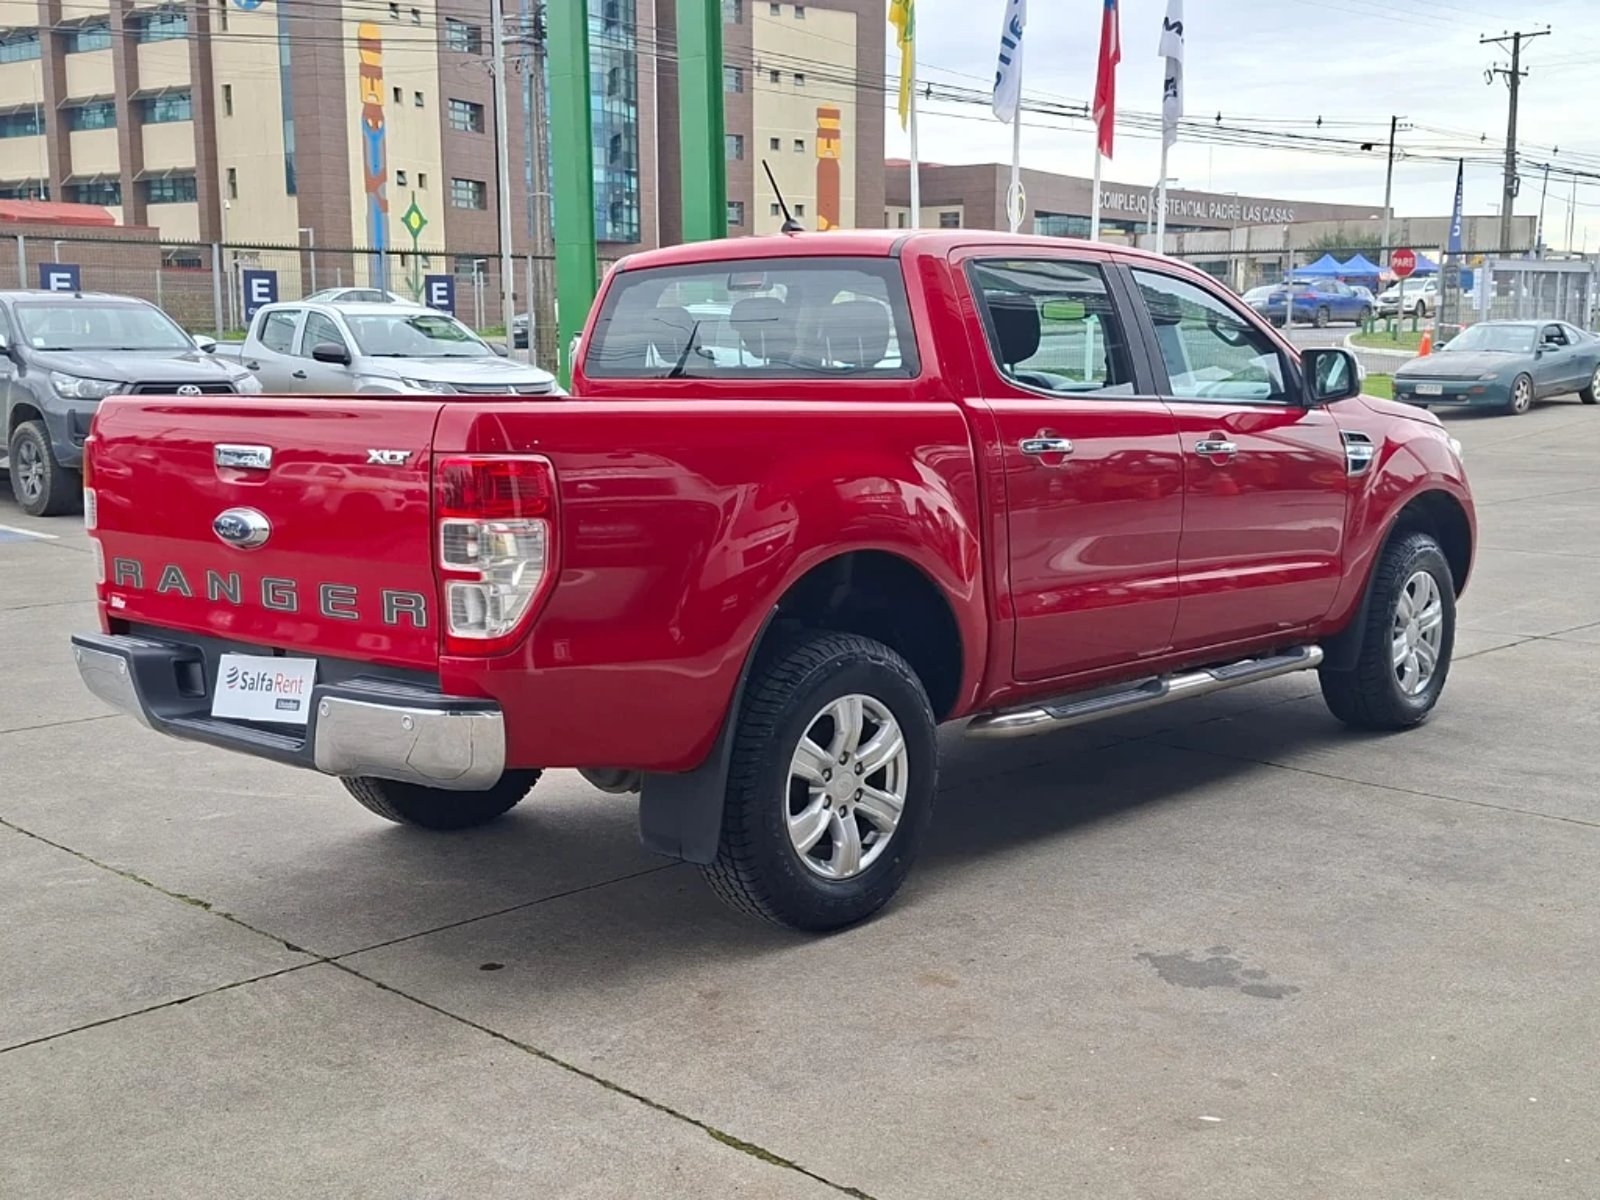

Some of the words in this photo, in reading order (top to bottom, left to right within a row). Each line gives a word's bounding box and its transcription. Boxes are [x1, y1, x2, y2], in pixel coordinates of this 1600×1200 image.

[1098, 191, 1148, 215] COMPLEJO
[1148, 195, 1209, 218] ASSTENCIAL
[1242, 204, 1261, 222] LAS
[1262, 207, 1295, 224] CASAS
[1392, 257, 1415, 268] PARE
[251, 278, 271, 302] E
[432, 282, 449, 304] E
[366, 449, 411, 465] XLT
[113, 557, 426, 628] RANGER
[240, 671, 304, 694] SalfaRent
